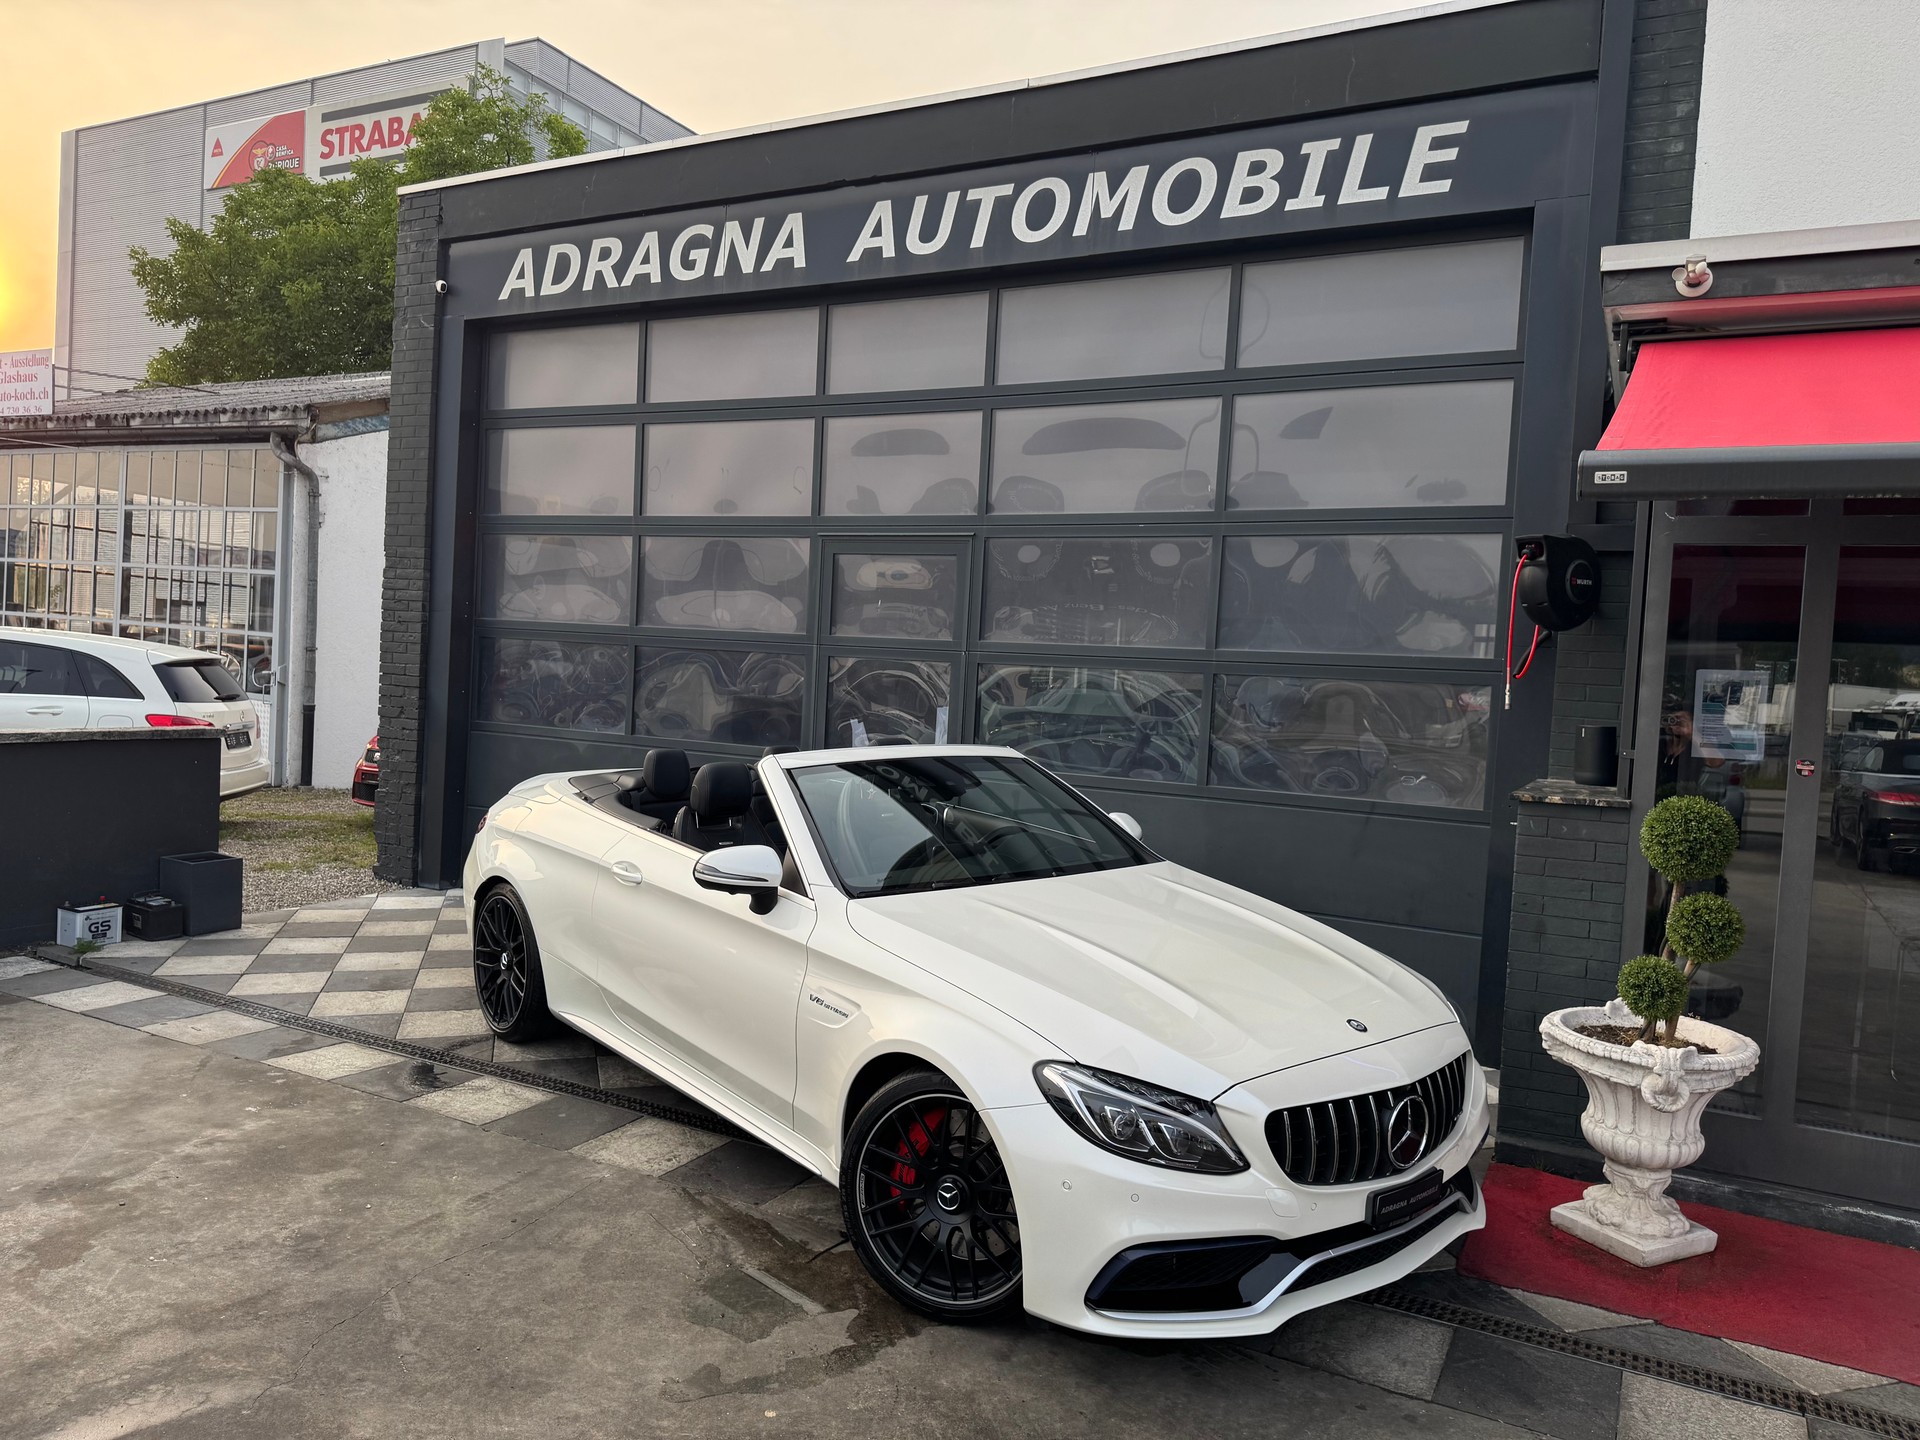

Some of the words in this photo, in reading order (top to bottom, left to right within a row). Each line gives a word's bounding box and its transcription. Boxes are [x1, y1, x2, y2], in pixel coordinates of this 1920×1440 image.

[320, 112, 422, 159] STRABA
[498, 212, 806, 300] ADRAGNA
[846, 120, 1470, 263] AUTOMOBILE
[10, 354, 49, 369] Ausstellung
[7, 407, 19, 415] 730
[33, 405, 43, 413] 36
[88, 920, 112, 934] GS
[1380, 1200, 1407, 1215] ADRAGNA
